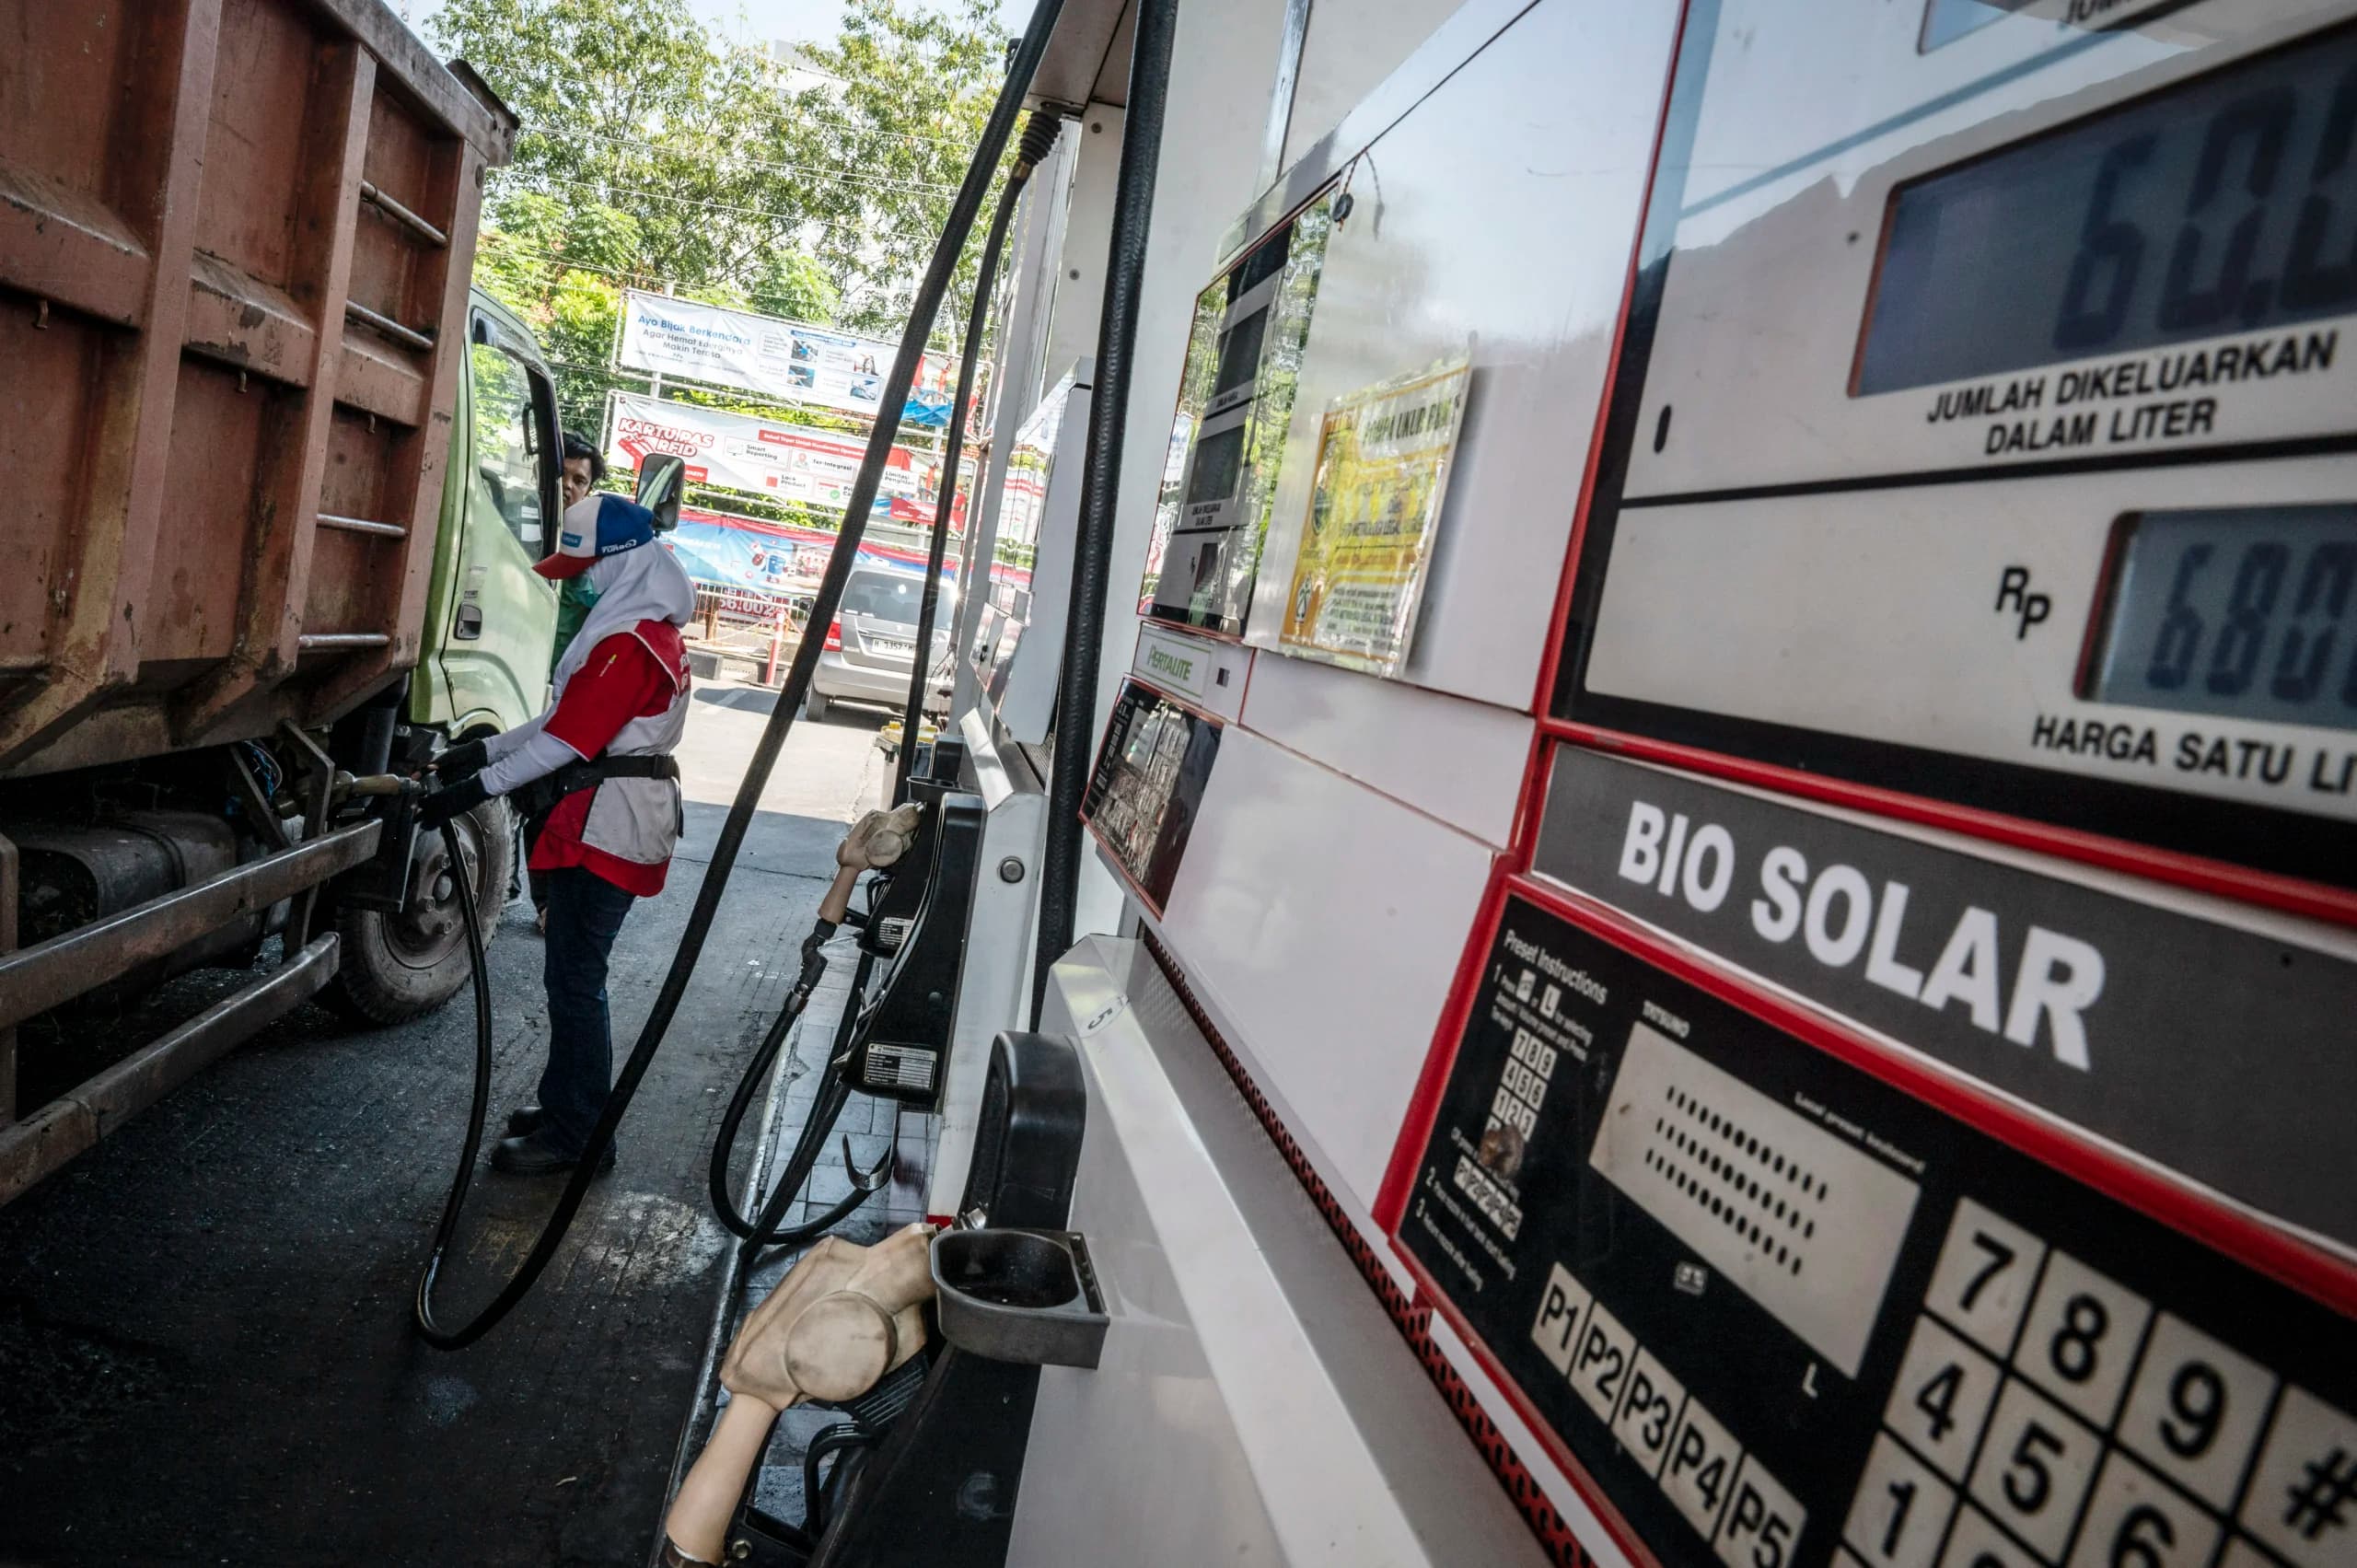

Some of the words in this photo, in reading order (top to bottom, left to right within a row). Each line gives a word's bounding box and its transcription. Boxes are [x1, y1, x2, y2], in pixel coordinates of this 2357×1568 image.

[638, 315, 658, 326] Ayo
[661, 319, 685, 332] Bijak
[689, 324, 751, 345] Berkendara
[643, 329, 665, 341] Agar
[667, 332, 697, 345] Hemat
[663, 342, 690, 353] Makin
[1927, 378, 2046, 424] JUMLAH
[2056, 330, 2340, 407] DIKELUARKAN
[619, 418, 678, 442] KARTU
[656, 439, 698, 457] RFID
[747, 444, 766, 452] Smart
[1986, 412, 2098, 456] DALAM
[2110, 398, 2217, 445] LITER
[1994, 566, 2053, 641] Rp
[2147, 543, 2357, 707] 680
[1147, 645, 1193, 681] PERTALITE
[2031, 714, 2158, 765] HARGA
[2175, 733, 2296, 785] SATU
[2309, 750, 2357, 794] LI
[1504, 929, 1538, 963] Preset
[1538, 948, 1608, 1005] Instructions
[1618, 800, 1735, 912] BIO
[1751, 846, 2106, 1073] SOLAR
[1803, 1363, 1817, 1399] L
[1958, 1229, 2016, 1313] 7
[2050, 1294, 2108, 1384] 8
[2159, 1360, 2228, 1459] 9
[2283, 1447, 2357, 1540] #
[1540, 1283, 1579, 1351] P1
[1580, 1323, 1624, 1401] P2
[1623, 1372, 1671, 1452] P3
[1672, 1422, 1725, 1514] P4
[1727, 1481, 1791, 1568] P5
[1915, 1362, 1965, 1443] 4
[2003, 1421, 2066, 1515] 5
[2110, 1504, 2177, 1568] 6
[1882, 1480, 1917, 1559] 1
